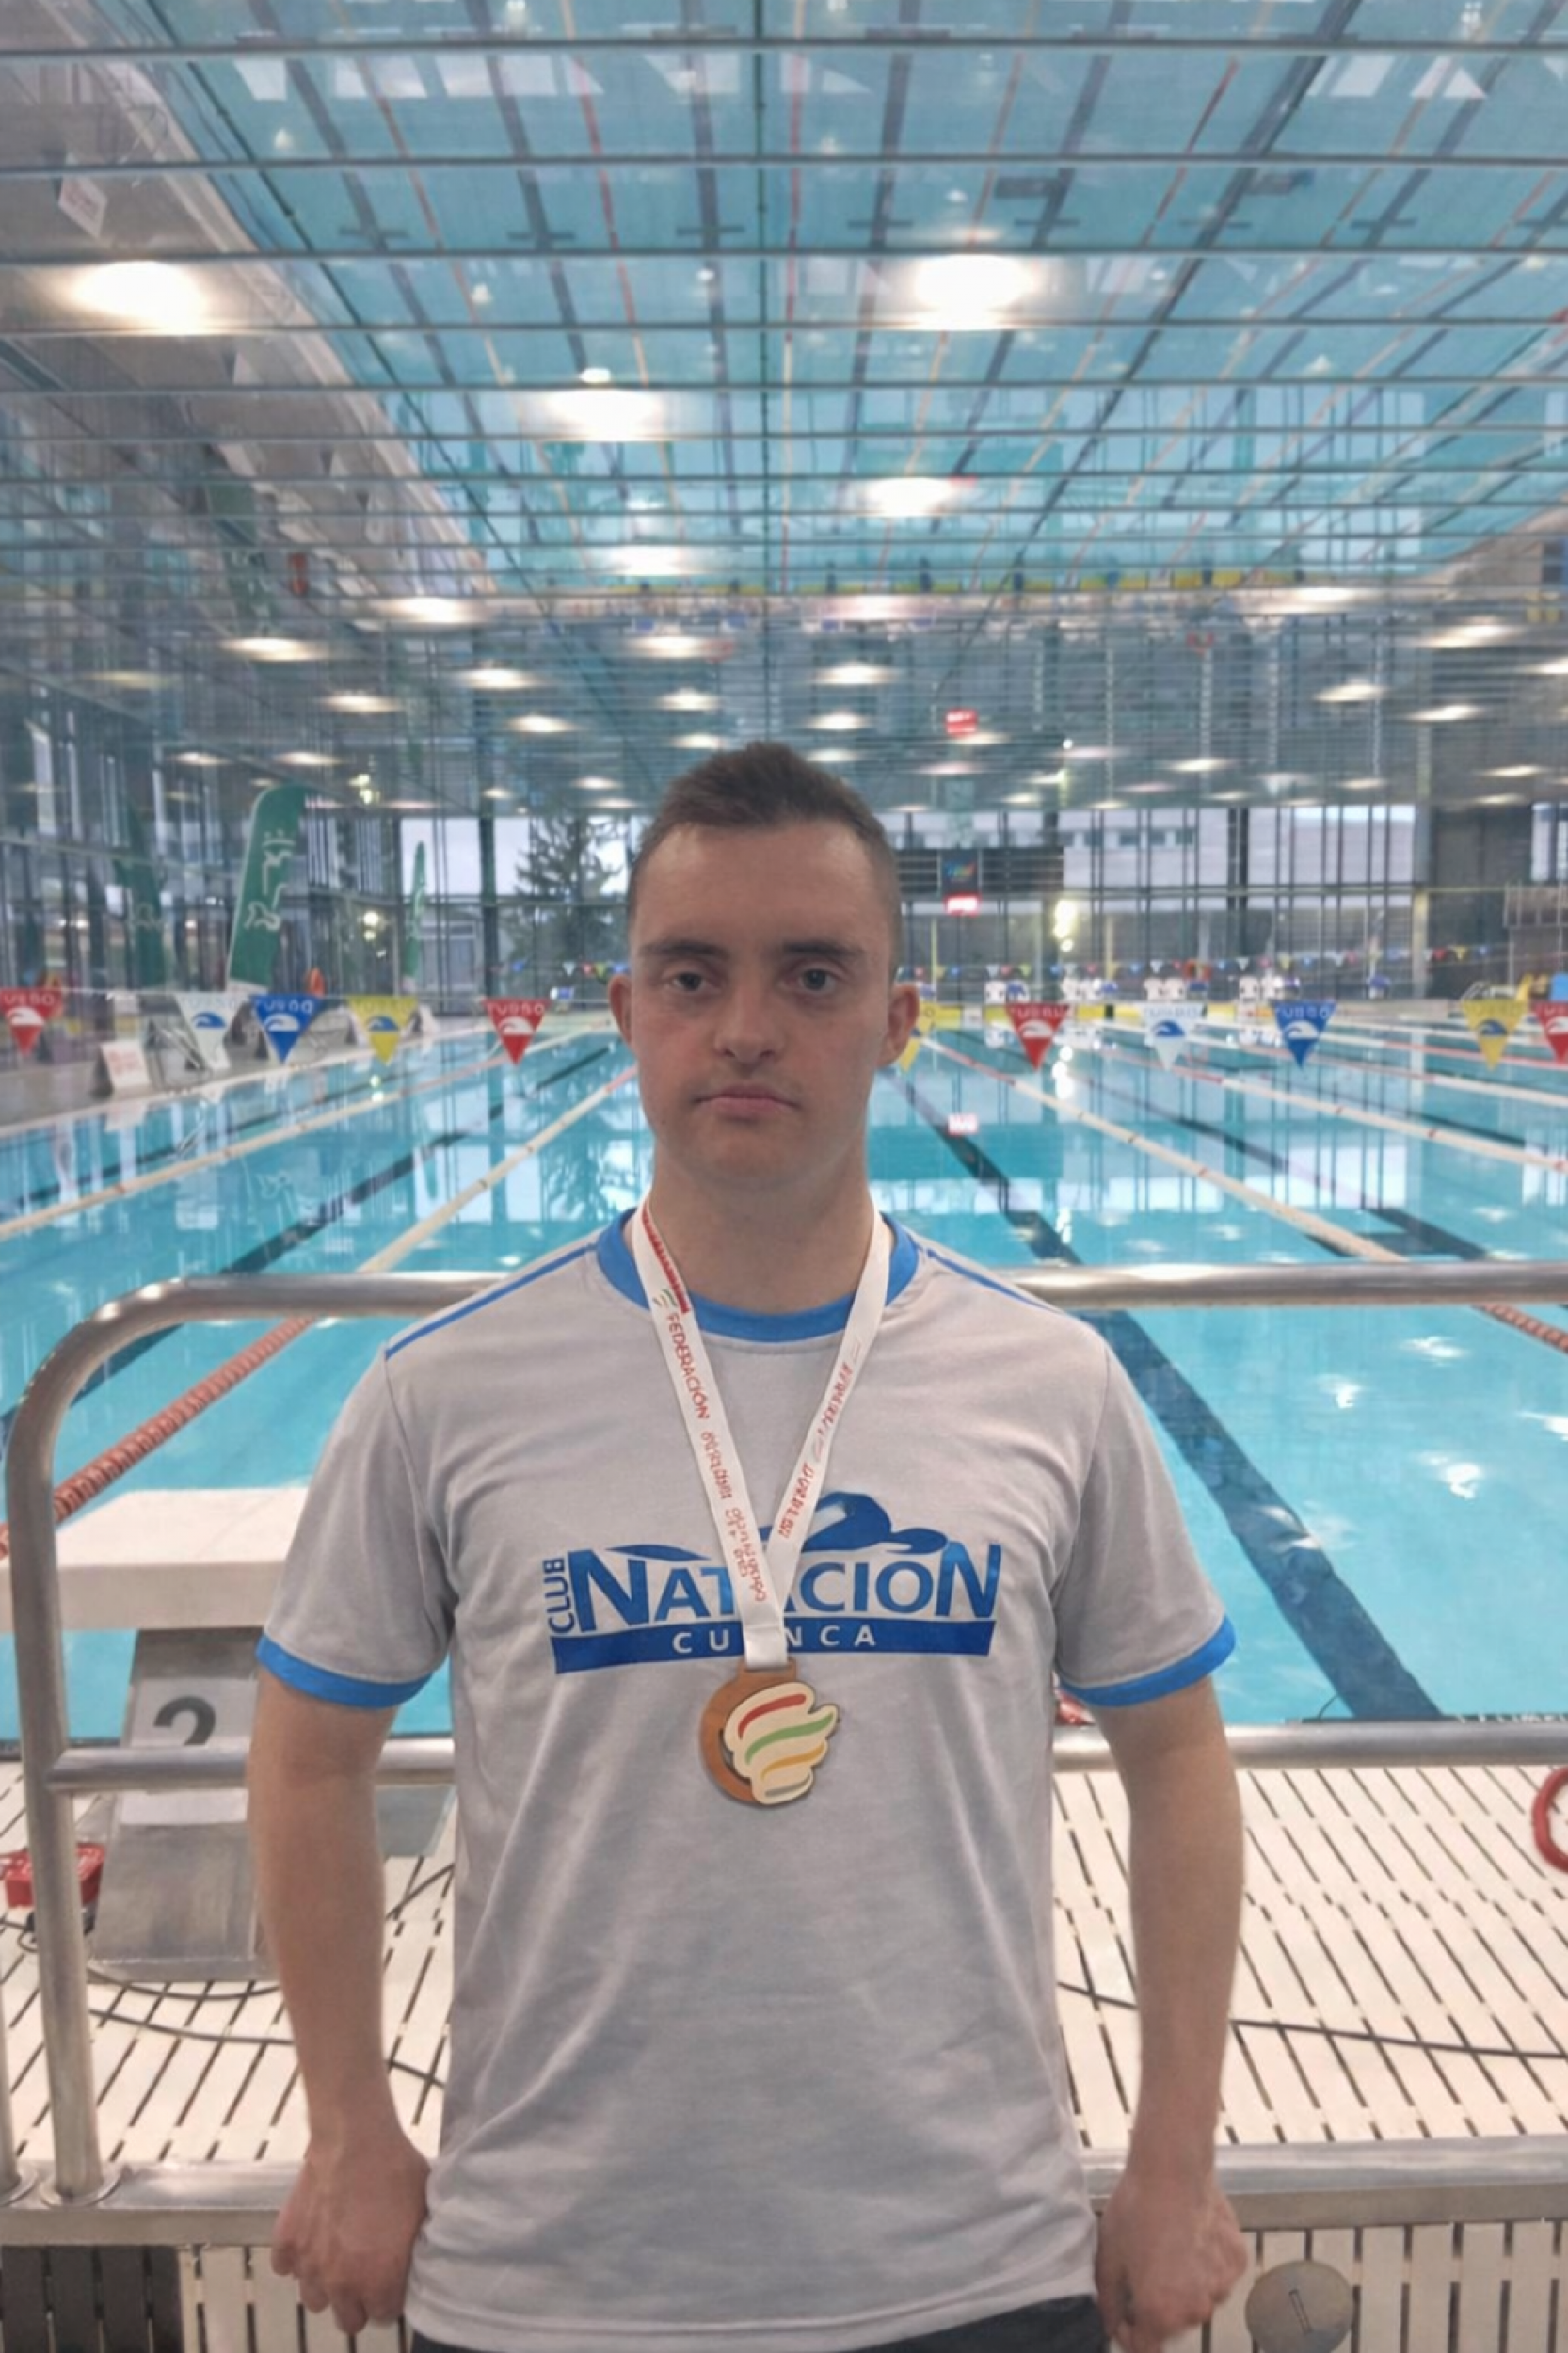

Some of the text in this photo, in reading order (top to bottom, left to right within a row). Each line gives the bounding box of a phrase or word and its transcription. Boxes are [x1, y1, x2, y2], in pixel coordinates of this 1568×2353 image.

[542, 1558, 575, 1633] CLUB
[567, 1541, 1002, 1633] NATCION
[671, 1625, 876, 1654] CUNCA
